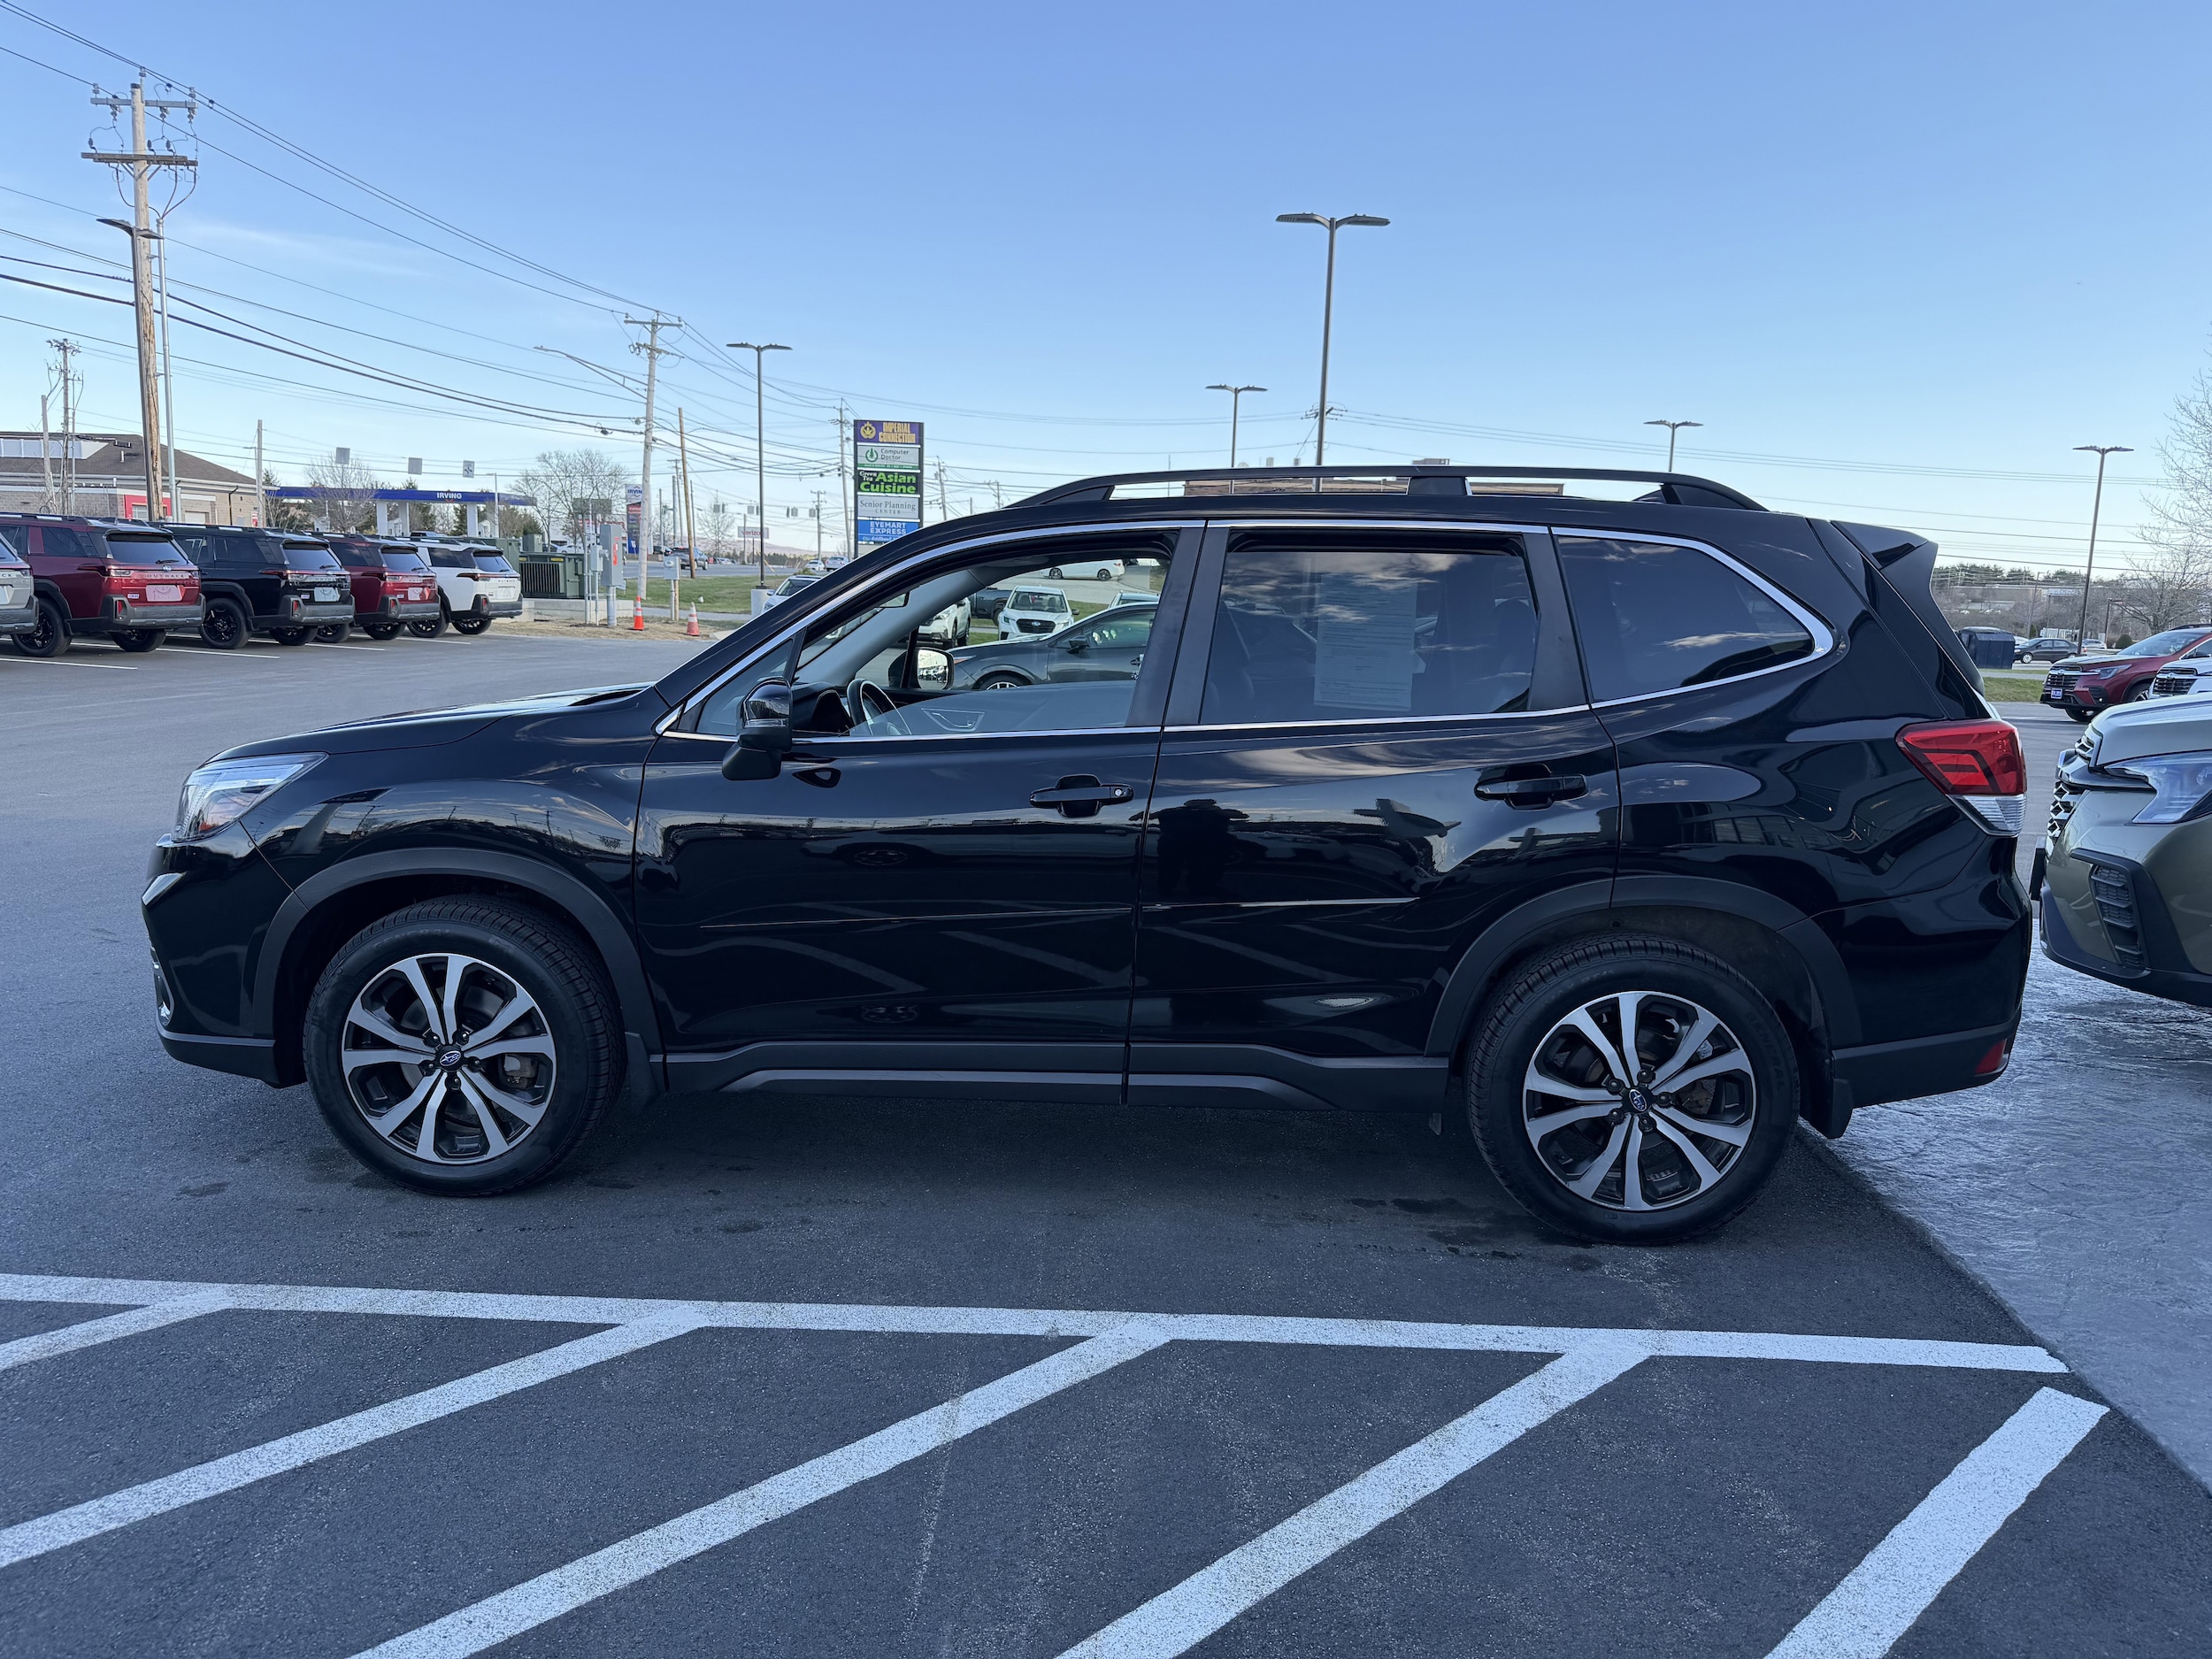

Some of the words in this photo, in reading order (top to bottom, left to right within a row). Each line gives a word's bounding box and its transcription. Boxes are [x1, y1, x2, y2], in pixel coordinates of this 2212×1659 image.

[883, 422, 910, 433] IMPERIAL
[879, 431, 916, 443] CONNECTION
[875, 472, 917, 483] Asian
[860, 481, 917, 494] Cuisine
[885, 501, 916, 511] Planning
